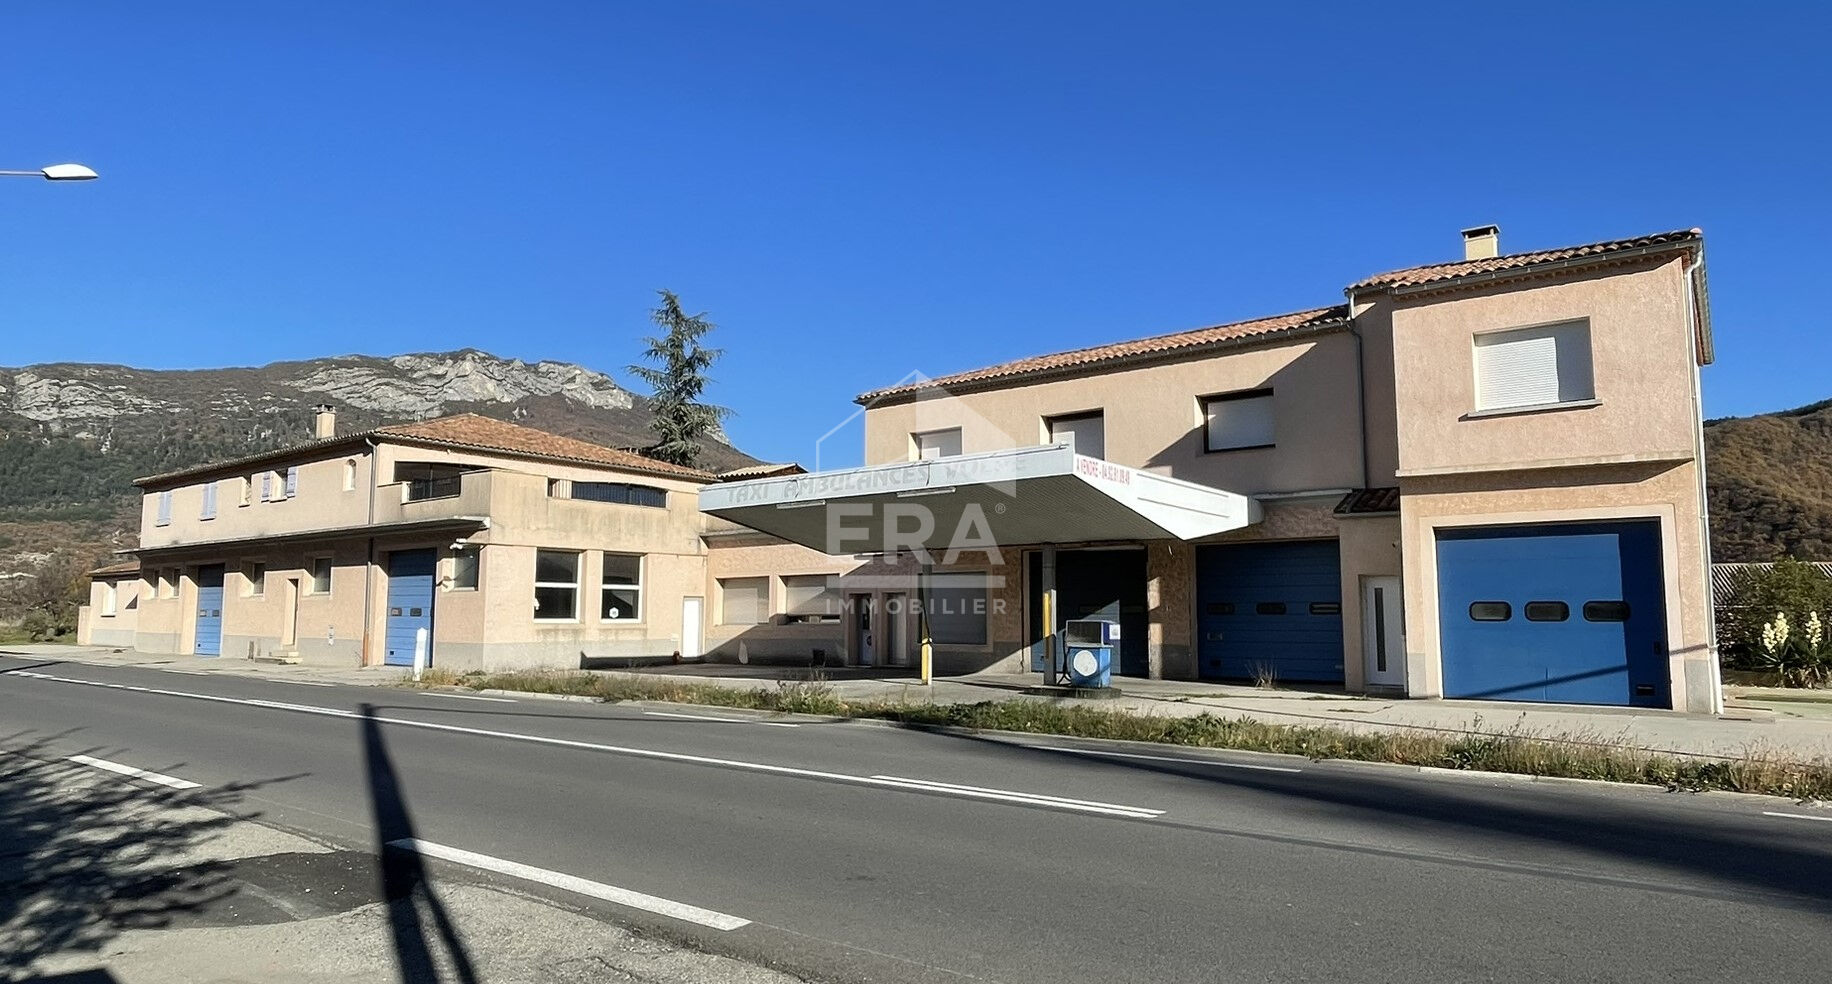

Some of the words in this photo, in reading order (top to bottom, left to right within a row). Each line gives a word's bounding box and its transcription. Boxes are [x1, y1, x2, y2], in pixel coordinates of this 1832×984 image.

[1080, 459, 1099, 478] VENDRE
[729, 486, 769, 504] TAXI
[785, 468, 928, 498] AMBULANCES
